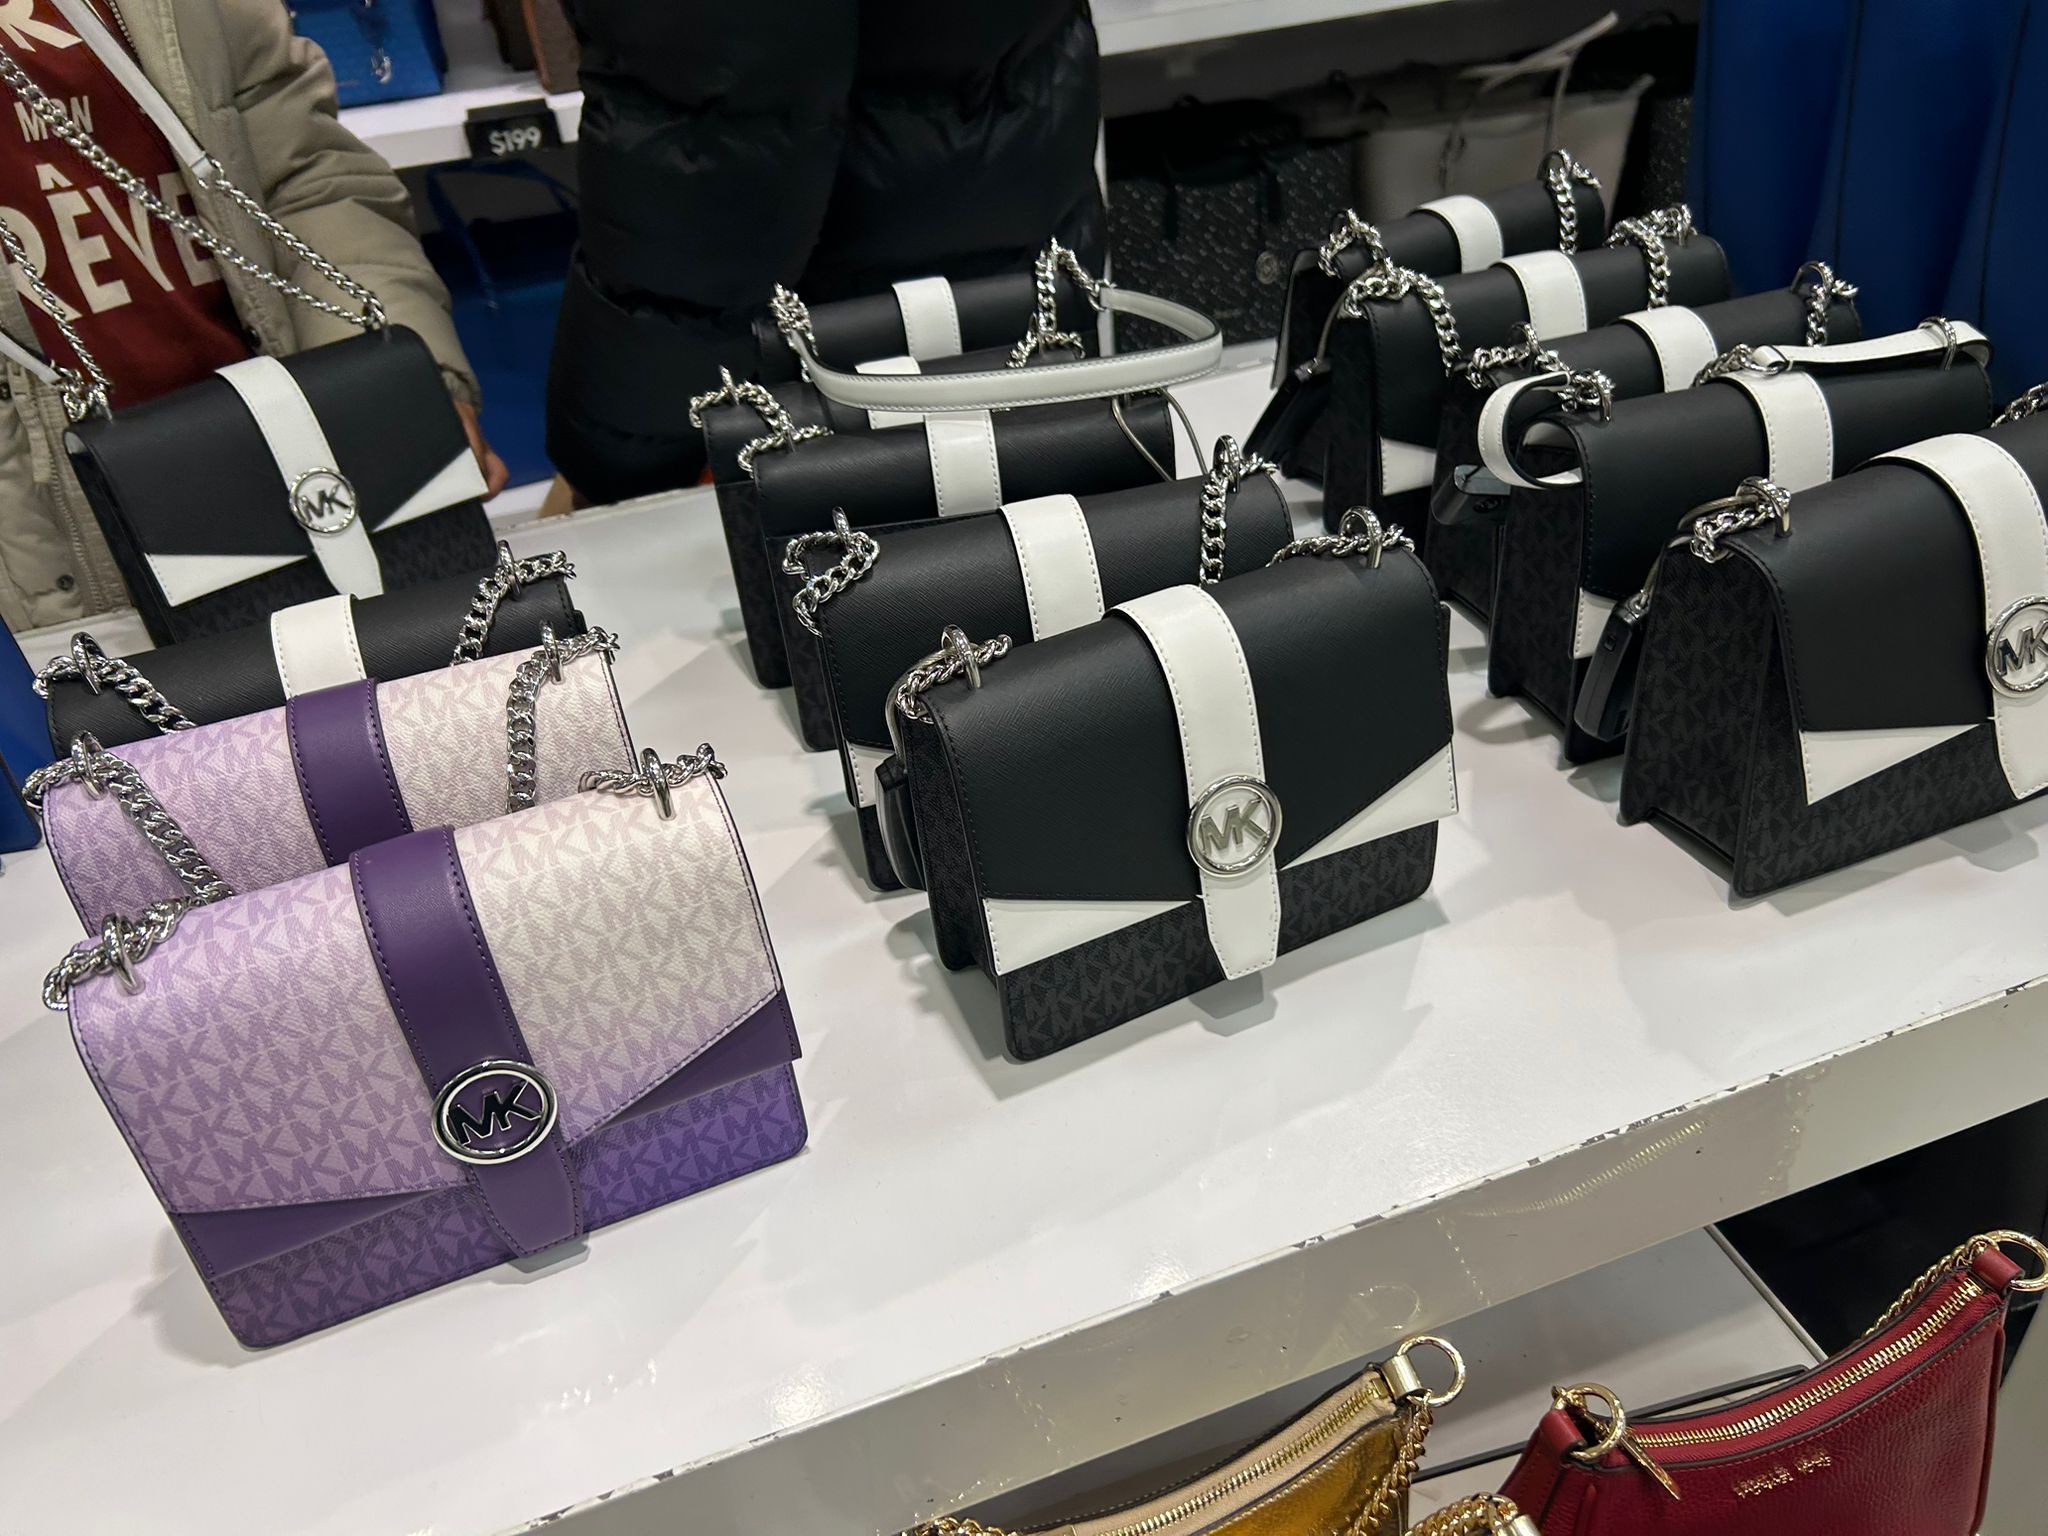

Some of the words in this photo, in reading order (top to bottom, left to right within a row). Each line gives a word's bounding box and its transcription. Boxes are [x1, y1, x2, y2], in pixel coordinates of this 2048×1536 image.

[489, 126, 541, 156] $199
[0, 164, 222, 320] RÊVE
[300, 482, 351, 522] MK
[389, 673, 450, 703] MK
[420, 684, 482, 724] MK
[195, 720, 258, 751] MK
[472, 810, 549, 852] MK
[543, 795, 621, 833] MK
[510, 825, 591, 876] MK
[583, 806, 661, 855] MK
[1200, 798, 1267, 857] MK
[248, 877, 327, 925] MK
[1081, 963, 1136, 1001] MK
[135, 1032, 230, 1088] MK
[216, 1003, 310, 1060] MK
[187, 1055, 277, 1111] MK
[268, 1028, 352, 1083] MK
[158, 1105, 250, 1159] MK
[240, 1076, 330, 1134] MK
[317, 1051, 403, 1105] MK
[448, 1080, 542, 1146] MK
[211, 1127, 299, 1180] MK
[290, 1099, 377, 1152] MK
[262, 1146, 348, 1199] MK
[337, 1115, 424, 1172] MK
[594, 1143, 661, 1186] MK
[659, 1119, 728, 1163] MK
[722, 1099, 790, 1140] MK
[630, 1158, 700, 1201] MK
[694, 1135, 756, 1177] MK
